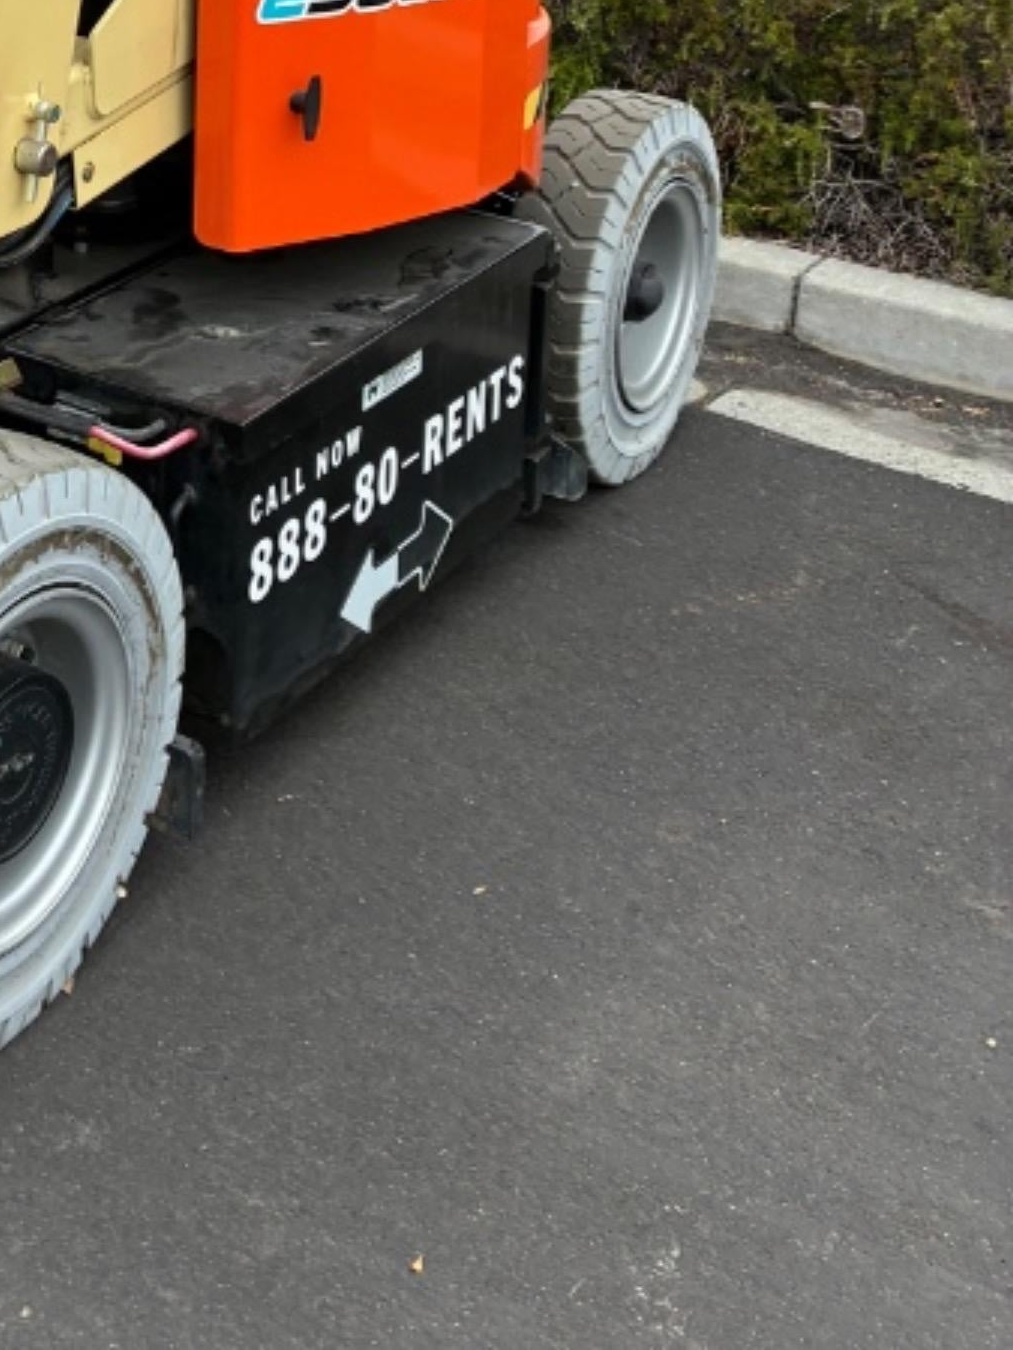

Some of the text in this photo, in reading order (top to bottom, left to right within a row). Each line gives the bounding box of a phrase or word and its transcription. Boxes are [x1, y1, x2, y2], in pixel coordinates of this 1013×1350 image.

[248, 354, 524, 603] 888-80-RENTS
[250, 425, 363, 525] CALL NOW
